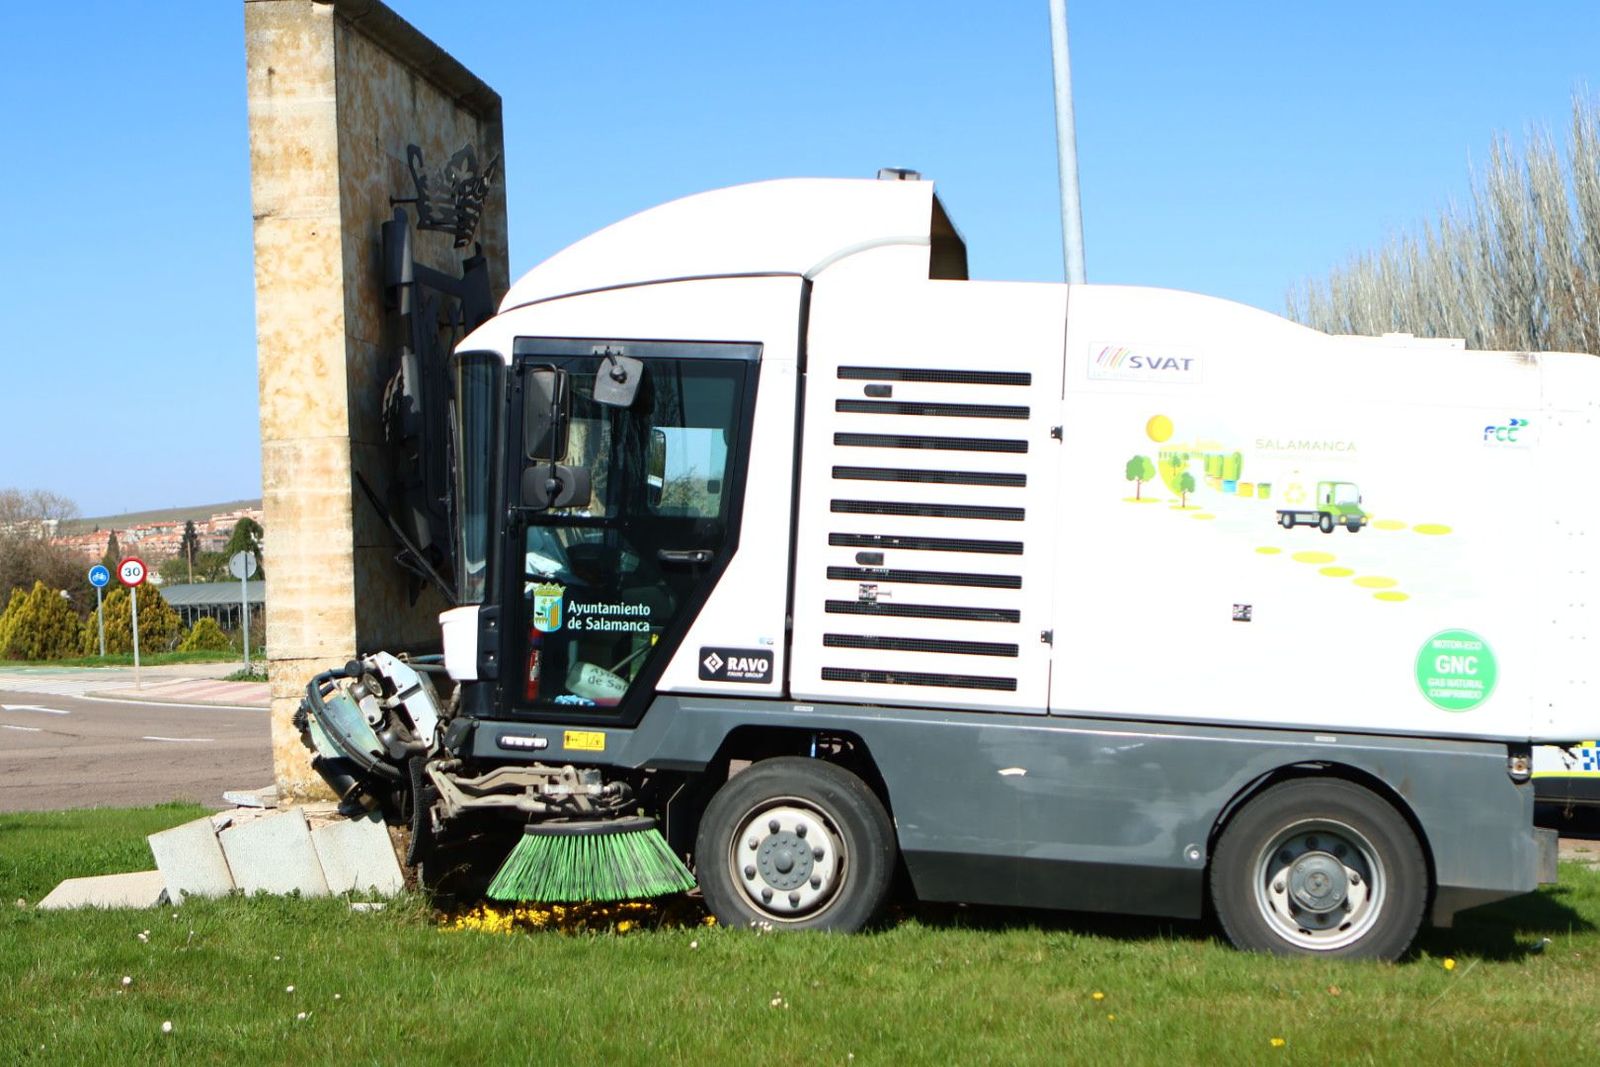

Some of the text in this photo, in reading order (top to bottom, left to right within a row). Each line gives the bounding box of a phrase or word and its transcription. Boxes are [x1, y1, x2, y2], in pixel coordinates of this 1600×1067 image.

[1129, 356, 1195, 371] SVAT
[1483, 425, 1519, 442] FCC
[1254, 438, 1357, 452] SALAMANCA
[125, 567, 141, 577] 30
[567, 600, 651, 617] Ayuntamiento
[567, 616, 650, 632] de Salamanca
[727, 656, 769, 673] RAVO
[1435, 654, 1478, 675] GNC
